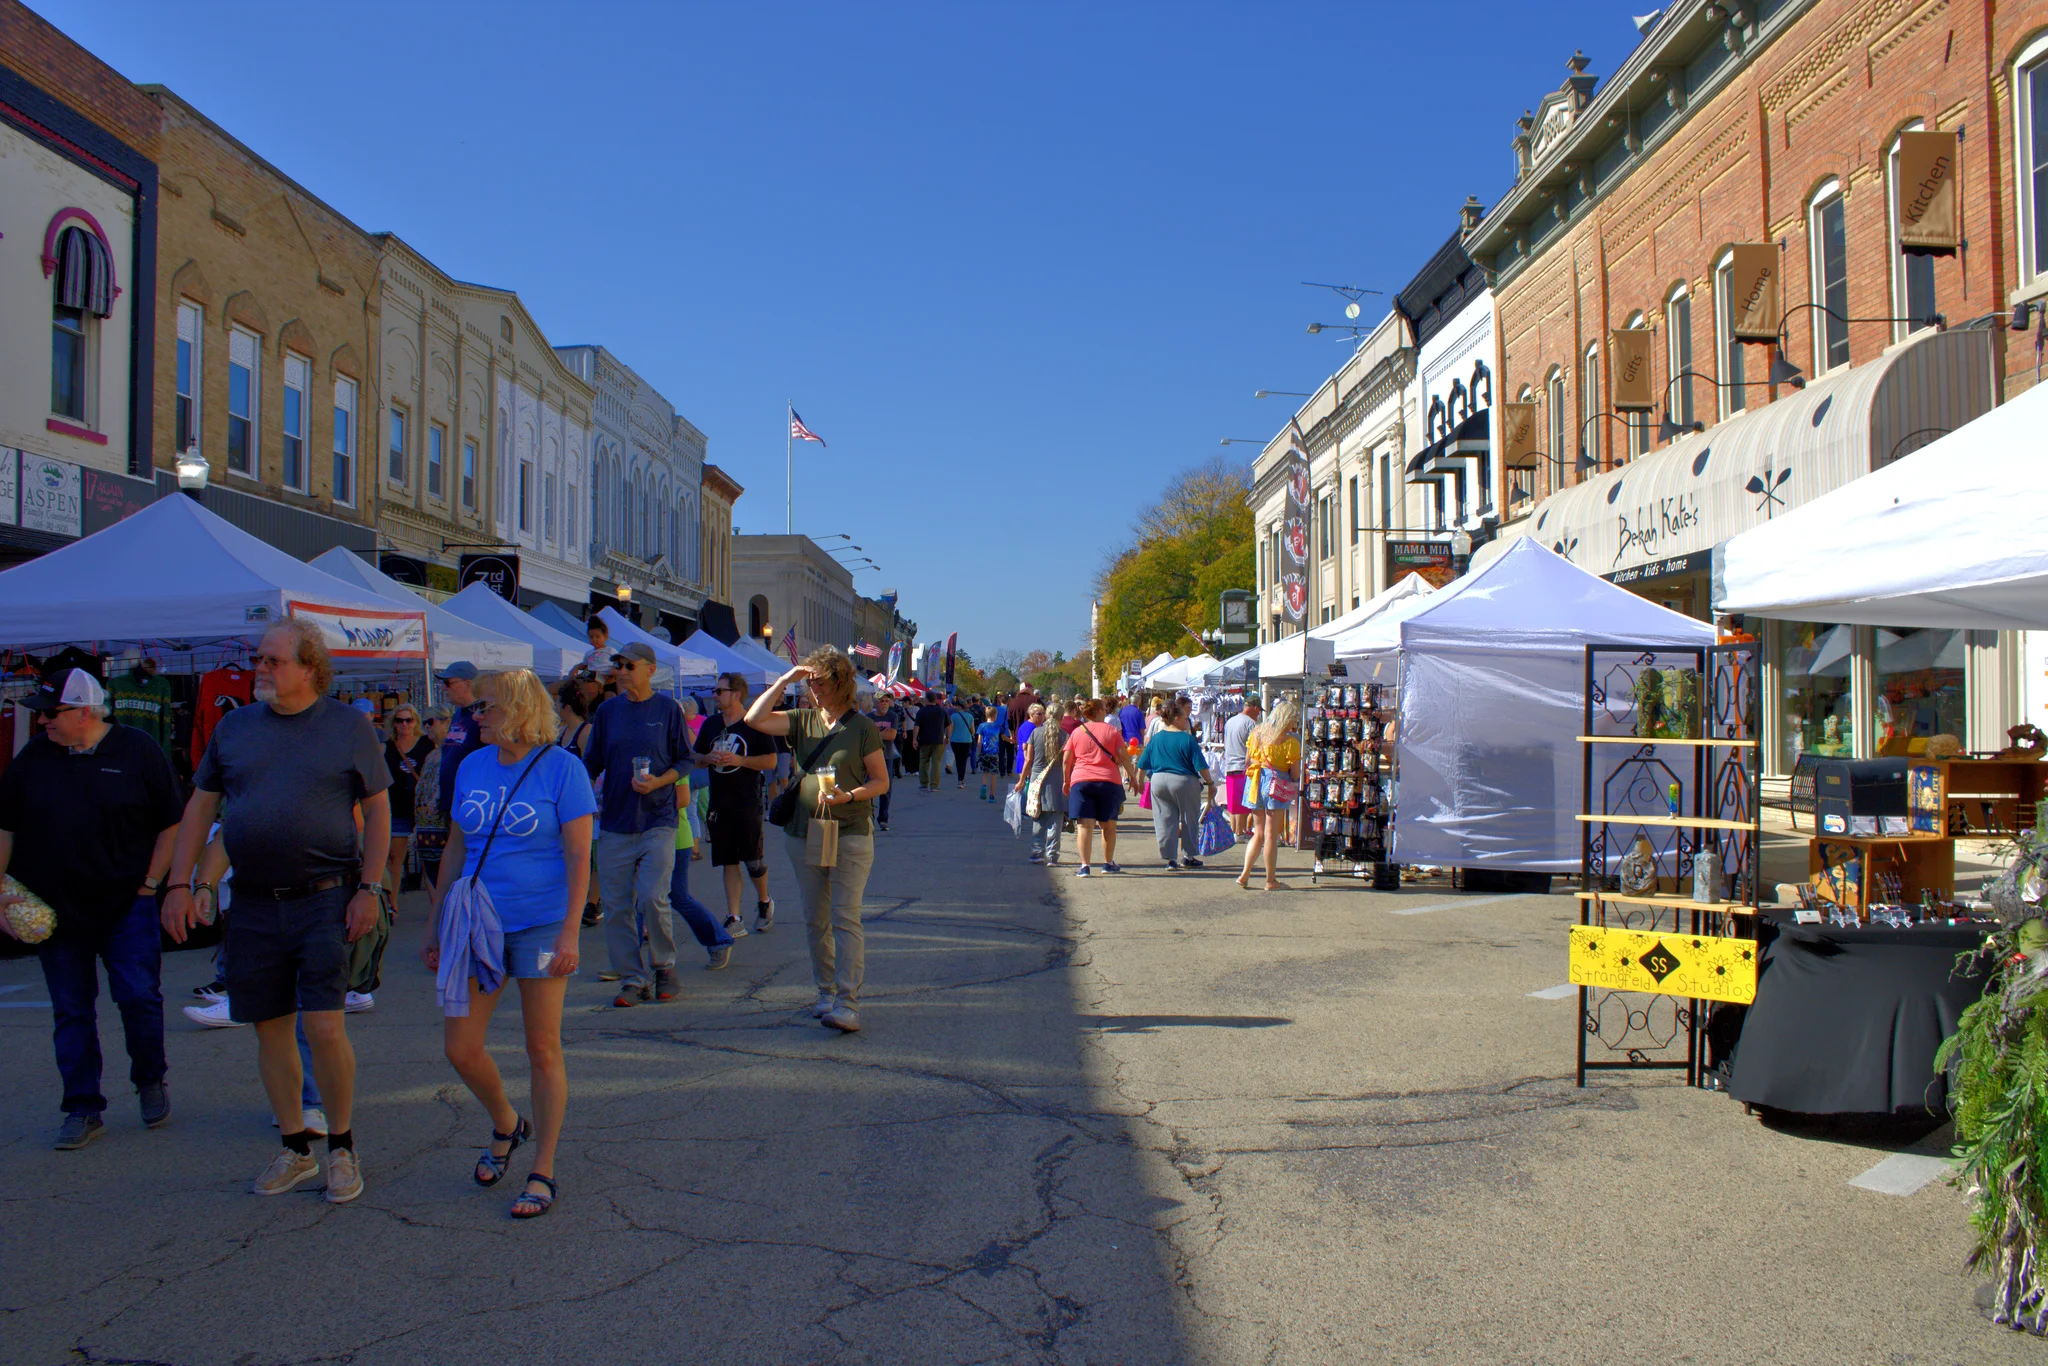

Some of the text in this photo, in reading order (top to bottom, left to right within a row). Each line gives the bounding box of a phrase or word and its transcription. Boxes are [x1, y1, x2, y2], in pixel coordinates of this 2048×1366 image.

[1905, 155, 1950, 223] Kitchen
[1741, 267, 1771, 312] Home
[1623, 355, 1643, 383] Gifts
[1514, 423, 1530, 445] Kids
[85, 471, 98, 500] 17
[24, 487, 79, 514] ASPEN
[1613, 492, 1698, 568] Bekah Kate's
[1394, 544, 1449, 554] MAMA MIA
[1613, 559, 1688, 583] kitchen kids home
[354, 628, 394, 648] CAMPO
[115, 699, 161, 713] GREEN BAY
[1651, 956, 1668, 974] SS
[1572, 964, 1754, 1001] Strangfeld Studios
